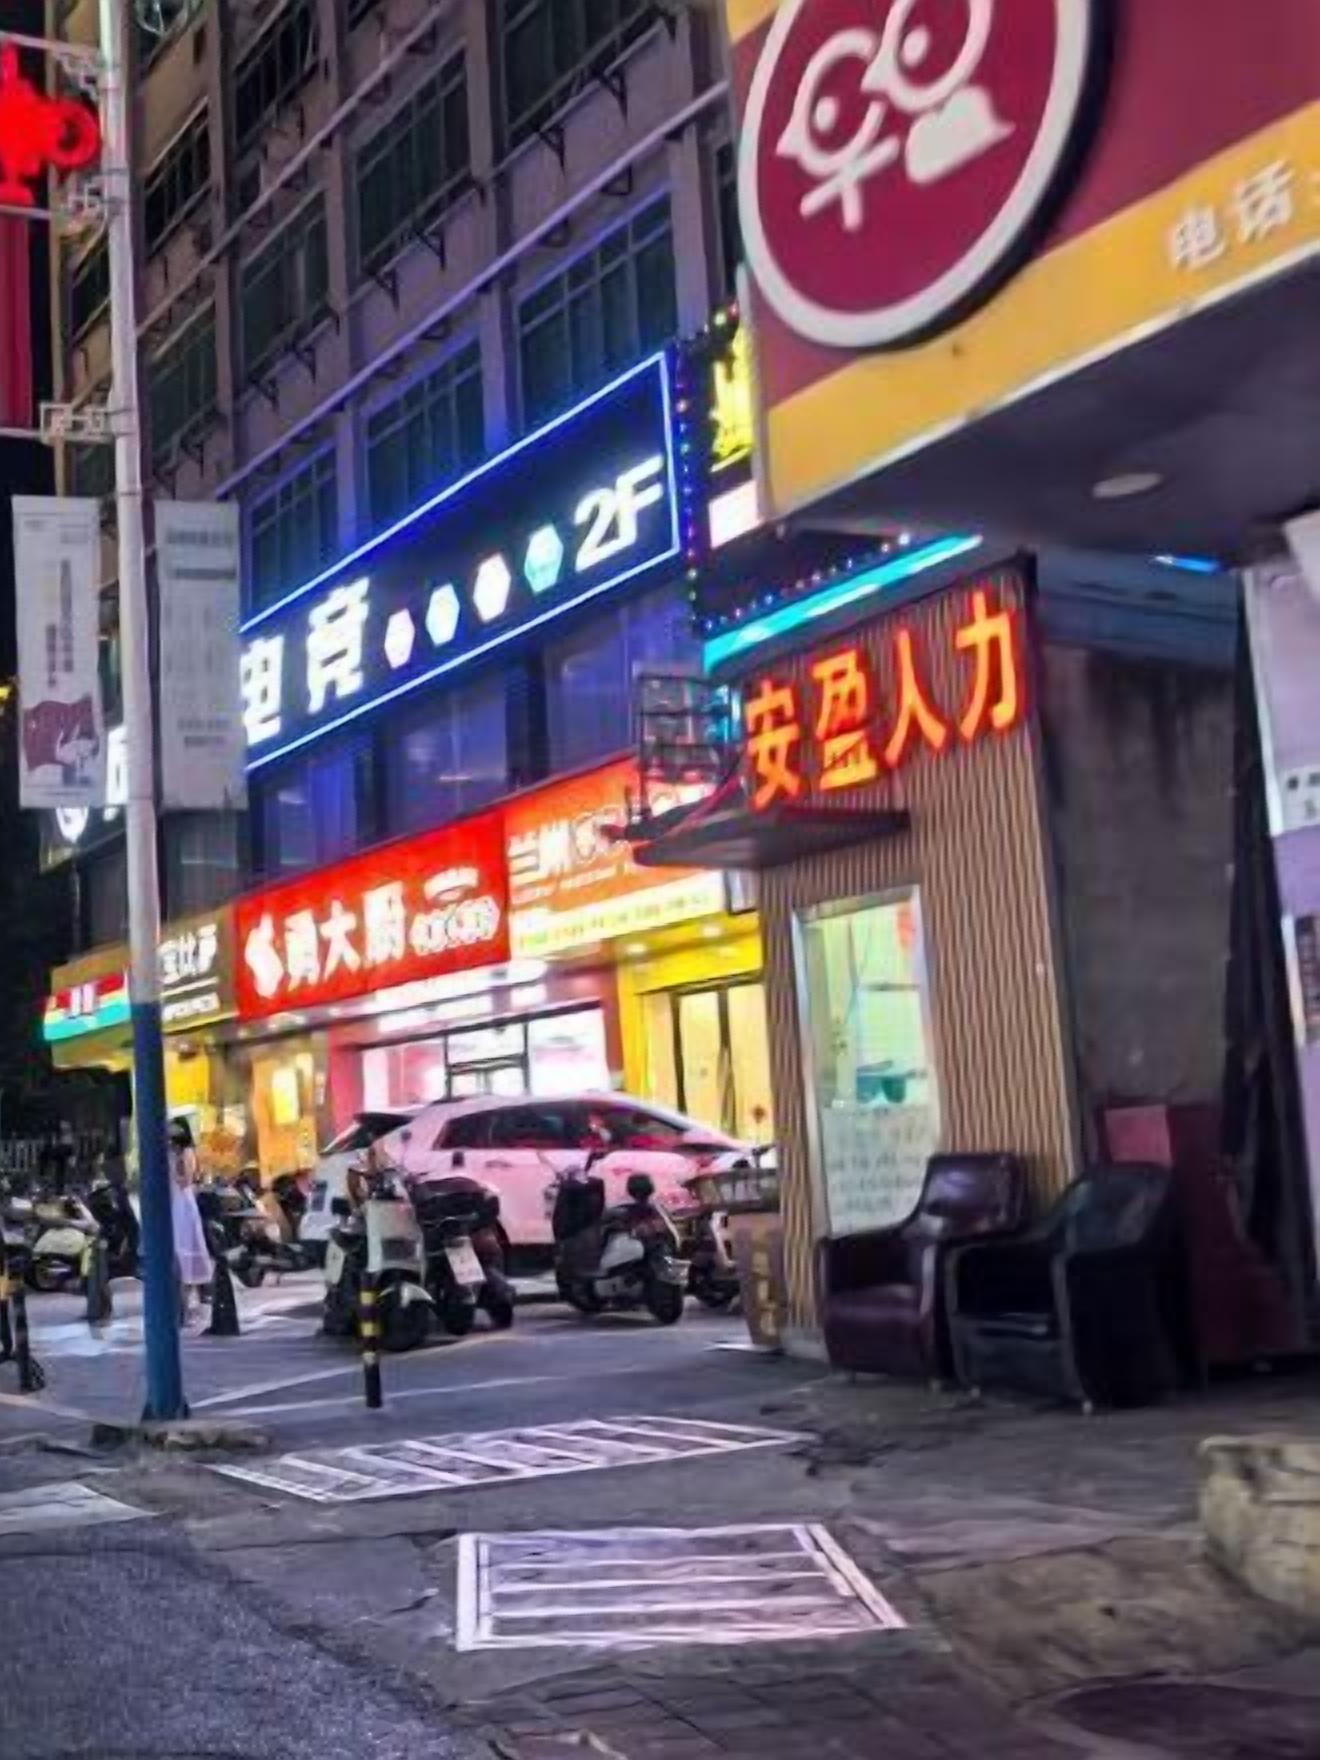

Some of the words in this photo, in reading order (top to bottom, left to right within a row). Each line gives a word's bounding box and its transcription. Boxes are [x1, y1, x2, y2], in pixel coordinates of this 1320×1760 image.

[1170, 158, 1297, 270] 电话
[574, 454, 665, 572] 2F
[744, 590, 1018, 810] 安盈人力
